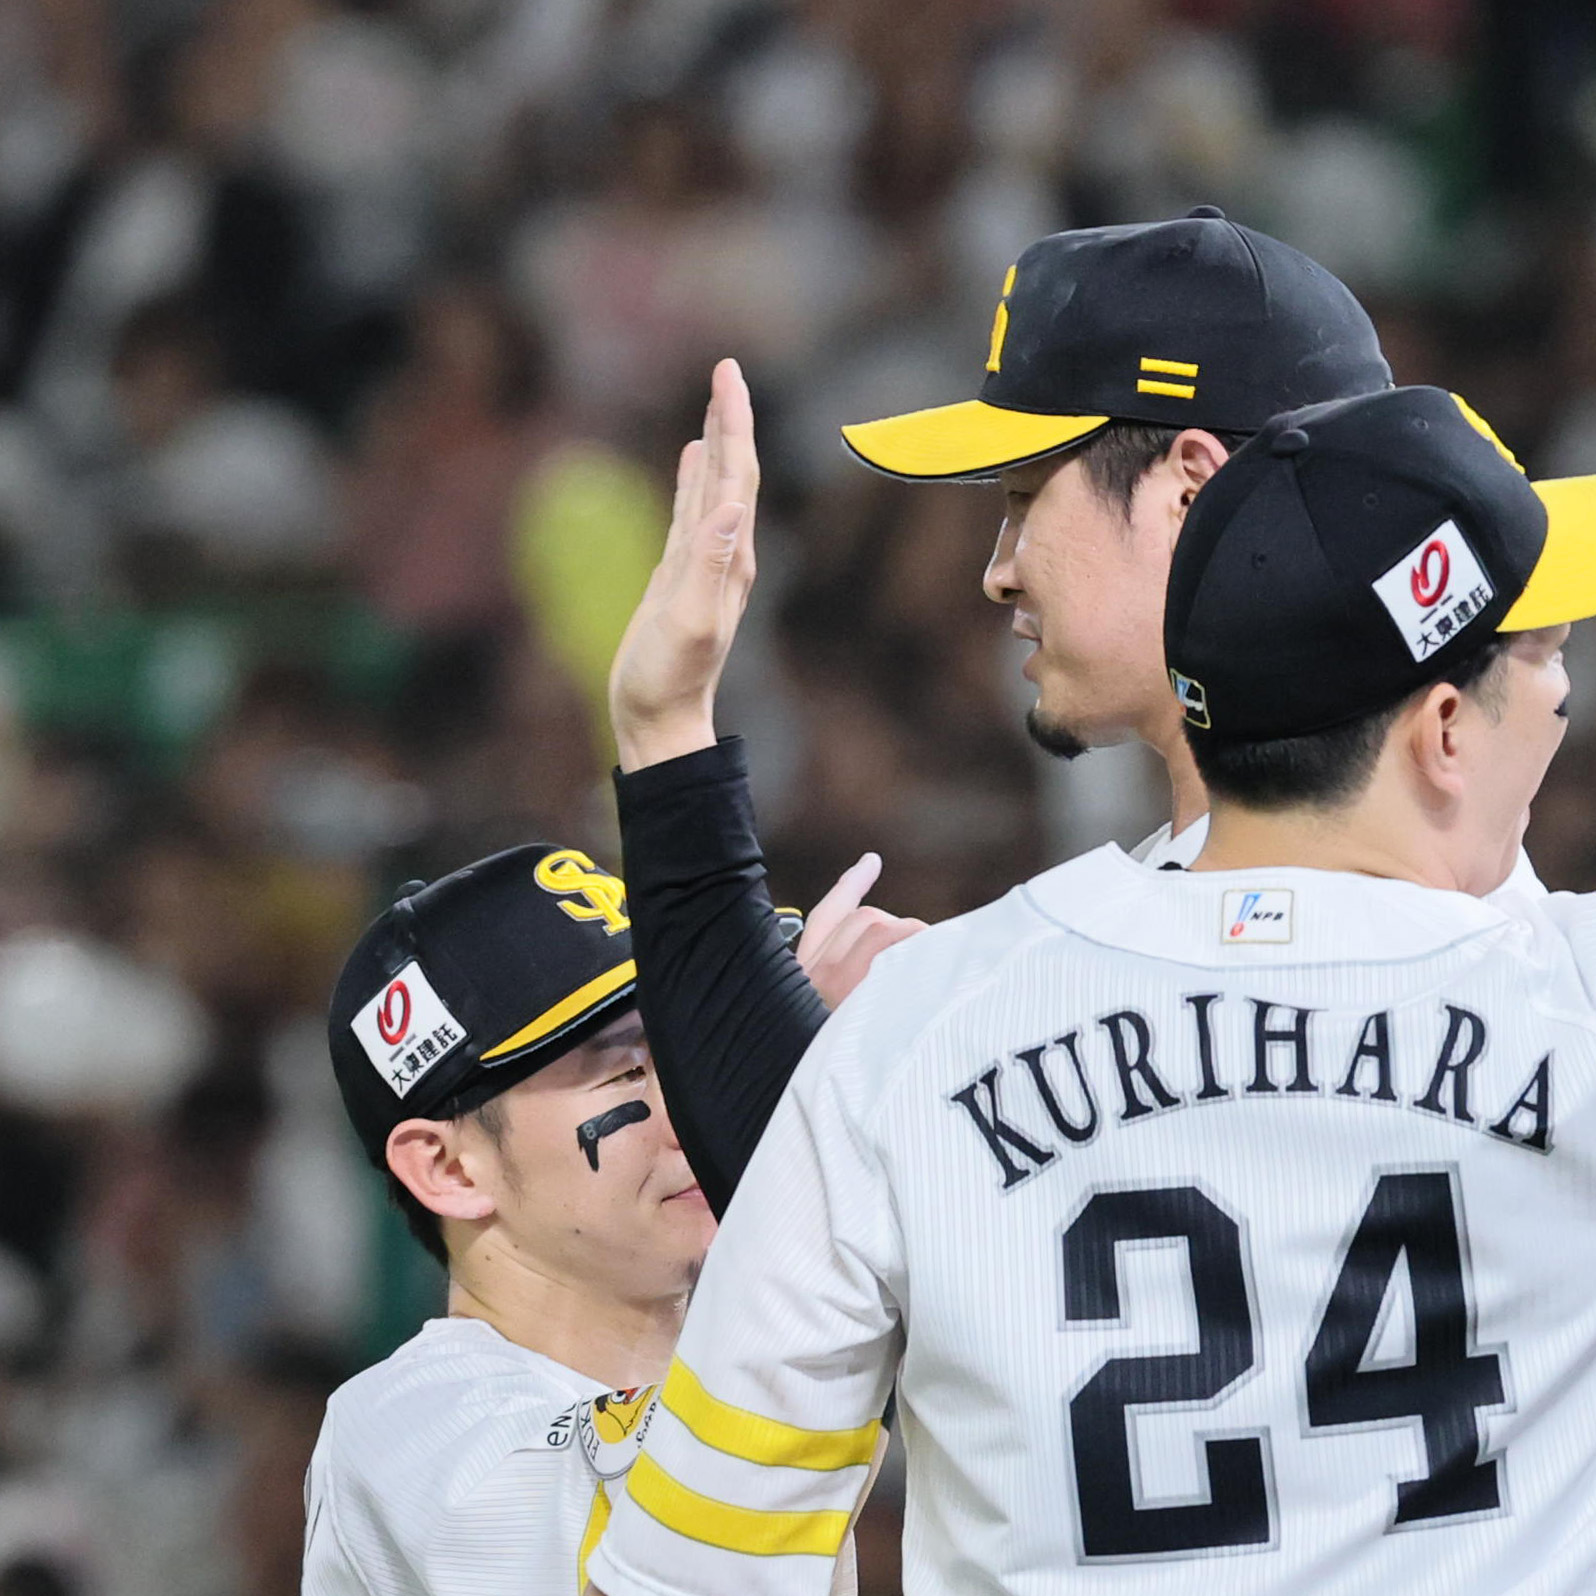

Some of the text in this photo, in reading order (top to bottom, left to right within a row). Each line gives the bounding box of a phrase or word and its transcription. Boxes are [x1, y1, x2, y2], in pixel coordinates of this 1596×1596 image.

[1249, 910, 1284, 921] NPB
[392, 1023, 458, 1093] 大東建託
[942, 992, 1555, 1195] KURIHARA
[1056, 1161, 1517, 1566] 24
